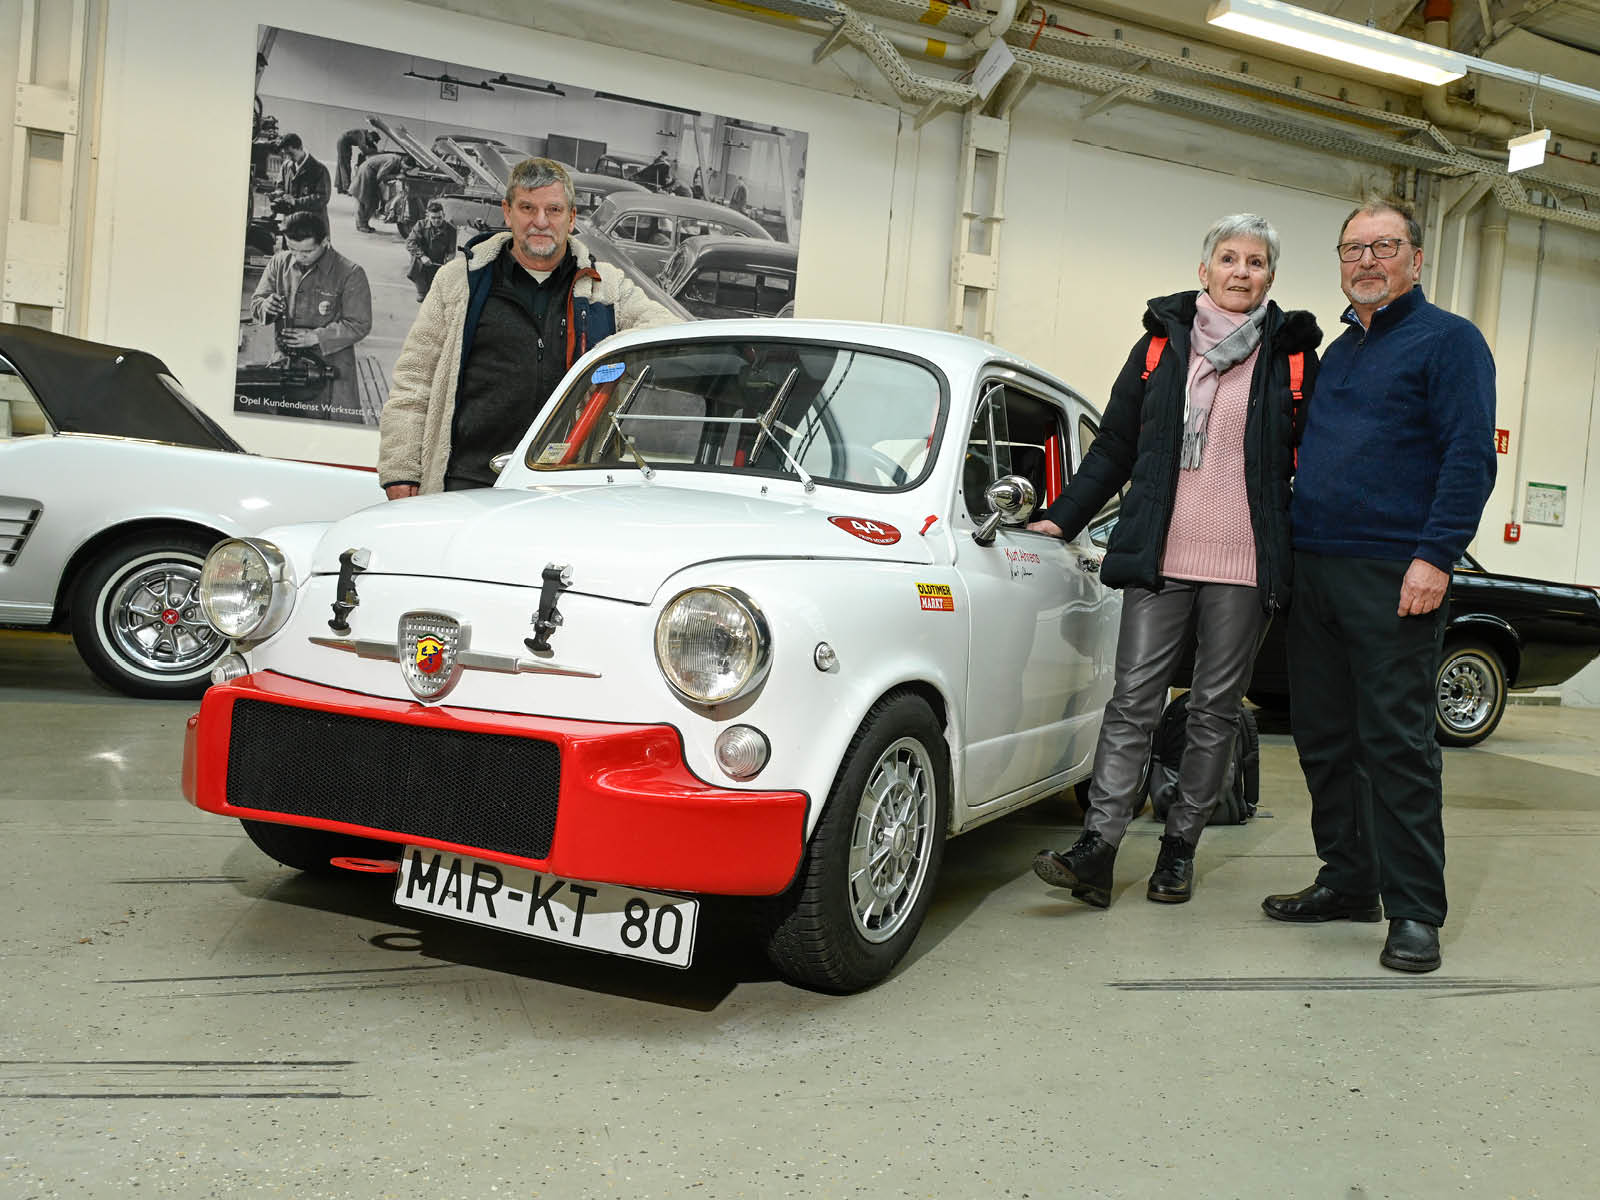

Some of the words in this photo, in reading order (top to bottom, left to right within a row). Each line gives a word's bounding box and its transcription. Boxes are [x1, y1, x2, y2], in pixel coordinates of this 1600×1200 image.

[239, 395, 261, 406] Opel
[263, 397, 319, 412] Kundendienst
[850, 520, 886, 536] 44
[917, 584, 952, 596] OLDTIMER
[921, 597, 943, 609] MARKT
[406, 850, 598, 937] MAR-KT
[620, 897, 684, 955] 80
